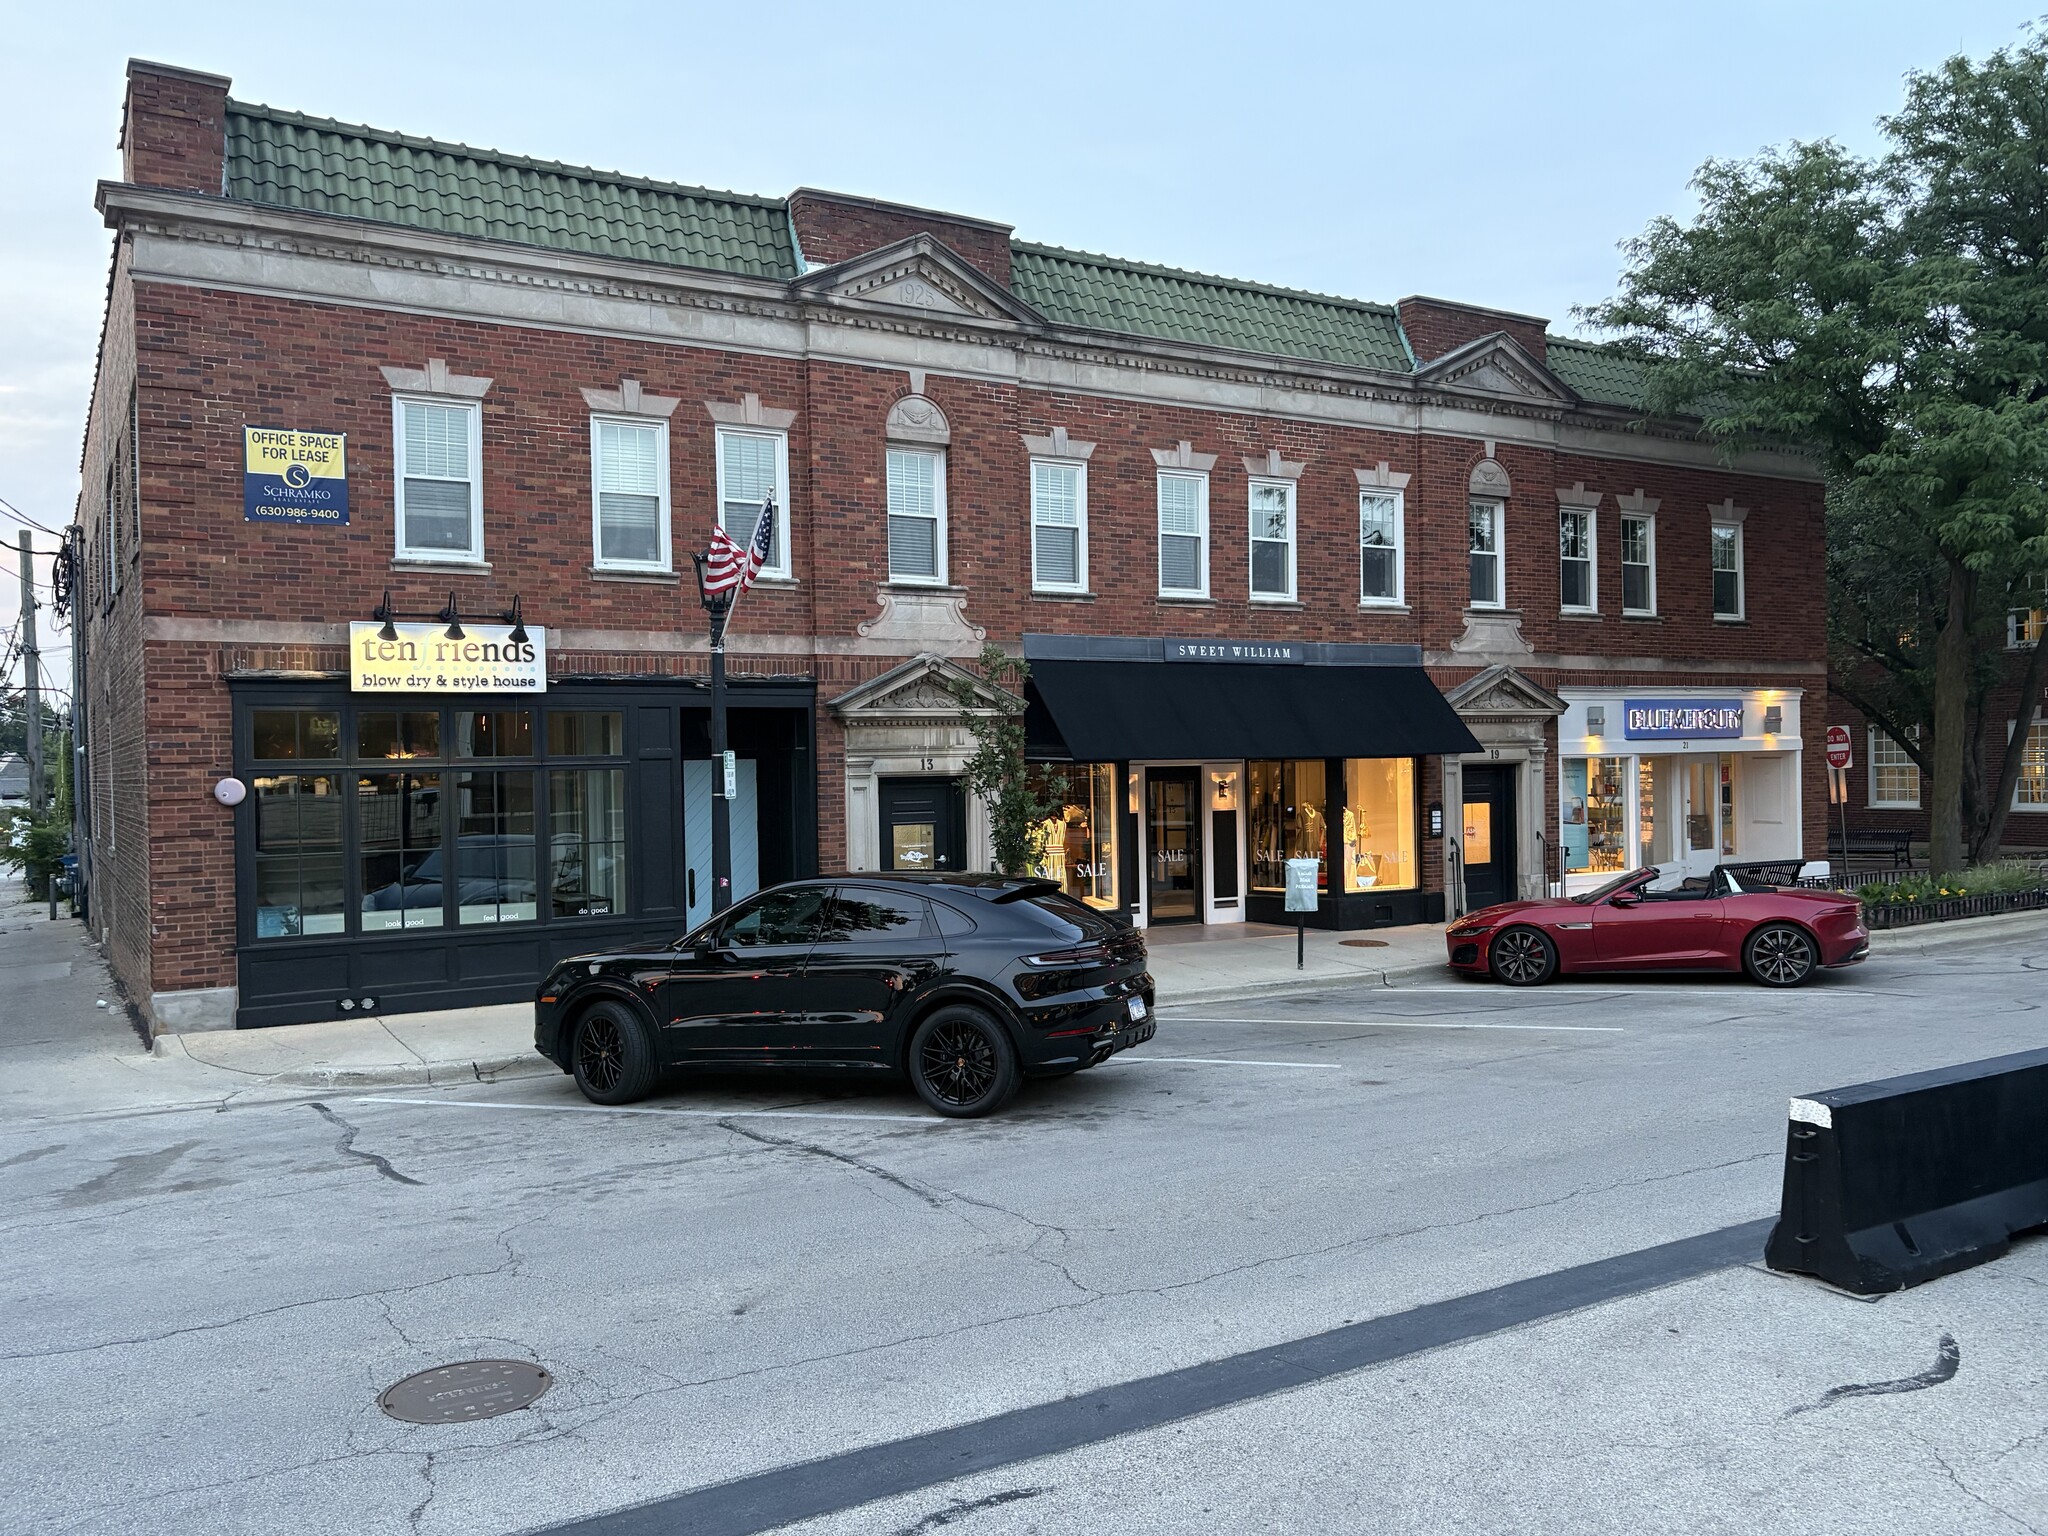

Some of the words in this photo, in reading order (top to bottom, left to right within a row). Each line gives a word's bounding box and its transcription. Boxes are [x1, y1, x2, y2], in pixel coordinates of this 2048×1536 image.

[899, 283, 935, 307] 1925
[251, 431, 296, 446] OFFICE
[300, 435, 339, 449] SPACE
[262, 446, 288, 460] FOR
[291, 449, 330, 463] LEASE
[255, 505, 340, 519] (630)986-9400
[1179, 645, 1225, 657] SWEET
[1232, 646, 1291, 658] WILLIAM
[362, 674, 402, 687] blow
[406, 674, 432, 688] dry
[436, 674, 448, 687] &
[452, 675, 489, 689] style
[493, 676, 537, 687] house
[1629, 708, 1745, 730] BLUEMERCURY
[1682, 741, 1689, 749] 21
[1827, 735, 1834, 743] DO
[1836, 734, 1846, 742] NOT
[1490, 749, 1500, 760] 19
[1830, 753, 1846, 761] ENTER
[920, 758, 934, 771] 13
[1158, 849, 1184, 863] SALE
[1256, 850, 1284, 862] SALE
[1076, 862, 1107, 878] SALE
[578, 907, 588, 915] do
[590, 906, 609, 915] good
[385, 920, 402, 928] look
[404, 918, 424, 928] good
[483, 914, 497, 922] feel
[500, 913, 519, 922] good
